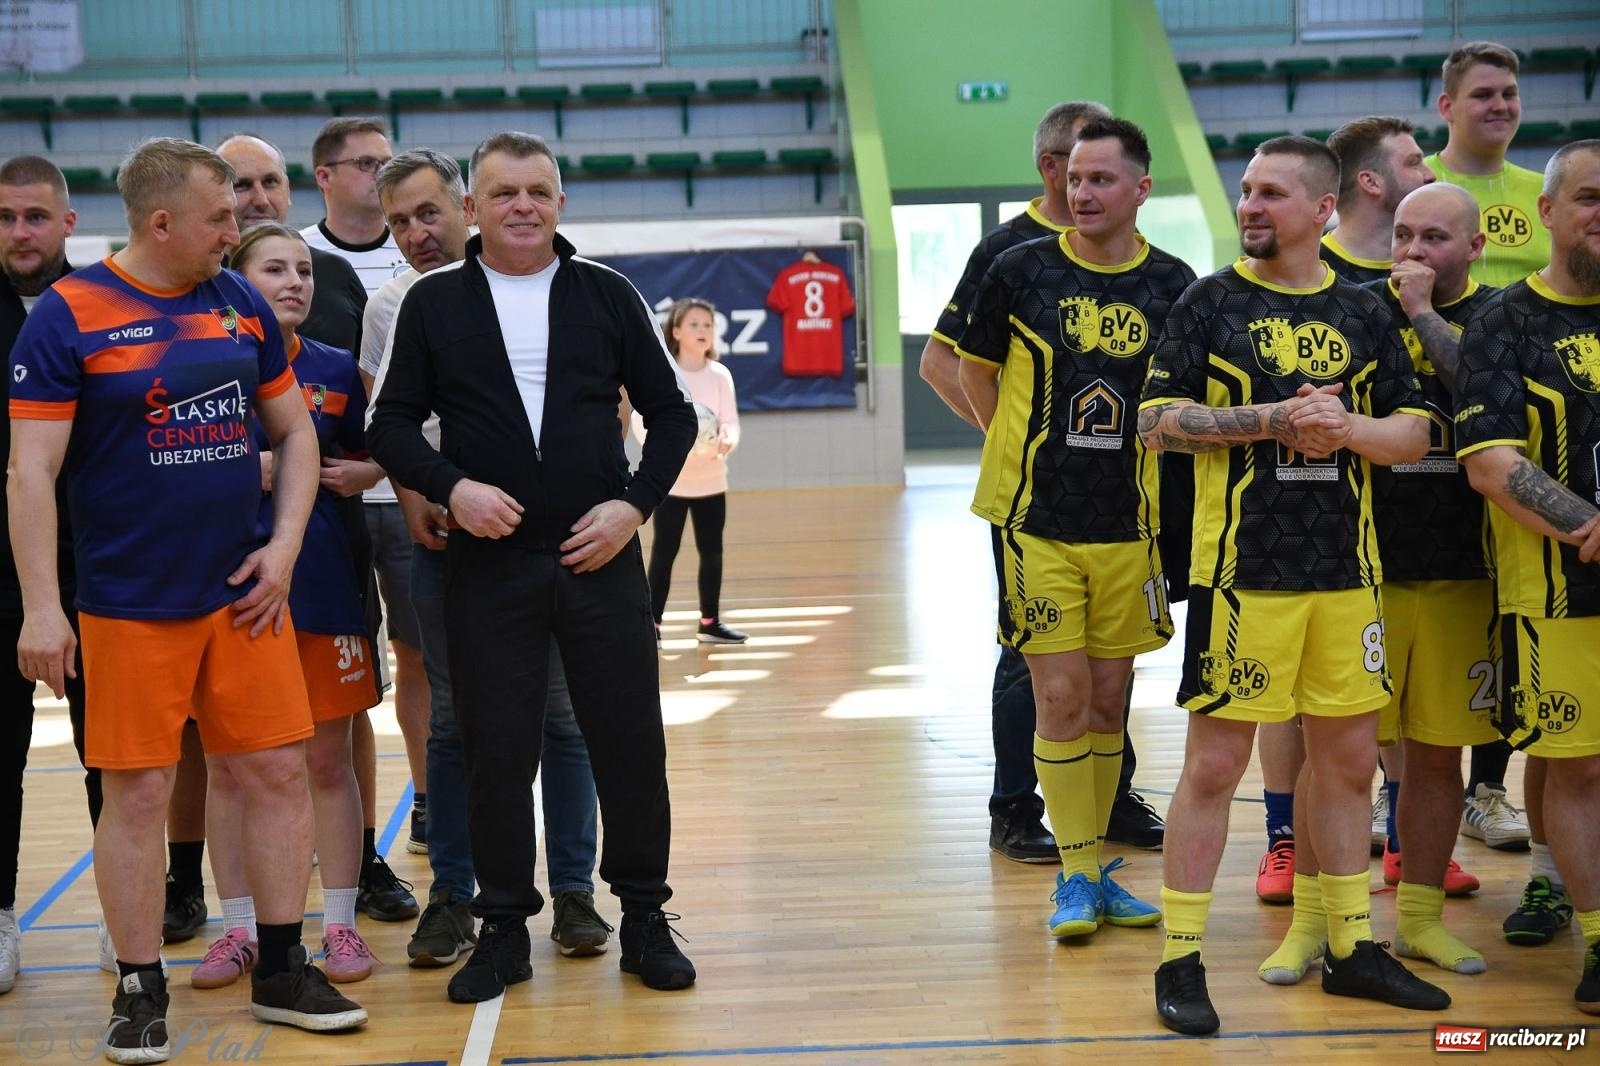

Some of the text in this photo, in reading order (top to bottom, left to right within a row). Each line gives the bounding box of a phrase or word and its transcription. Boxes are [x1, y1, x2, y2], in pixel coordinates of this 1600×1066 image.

[1487, 208, 1528, 236] BVB
[1499, 233, 1516, 244] 09
[804, 280, 825, 319] 8
[1100, 308, 1142, 343] BVB
[1110, 338, 1127, 352] 09
[1297, 327, 1344, 362] BVB
[1310, 359, 1329, 373] 09
[144, 377, 248, 424] ŚLĄSKIE
[146, 421, 249, 449] CENTRUM
[150, 438, 249, 466] UBEZPIECZEŃ
[1025, 600, 1058, 623] BVB
[1361, 617, 1385, 673] 8
[1229, 661, 1266, 689] BVB
[1236, 686, 1250, 696] 09
[1538, 695, 1576, 722] BVB
[1547, 721, 1563, 730] 09
